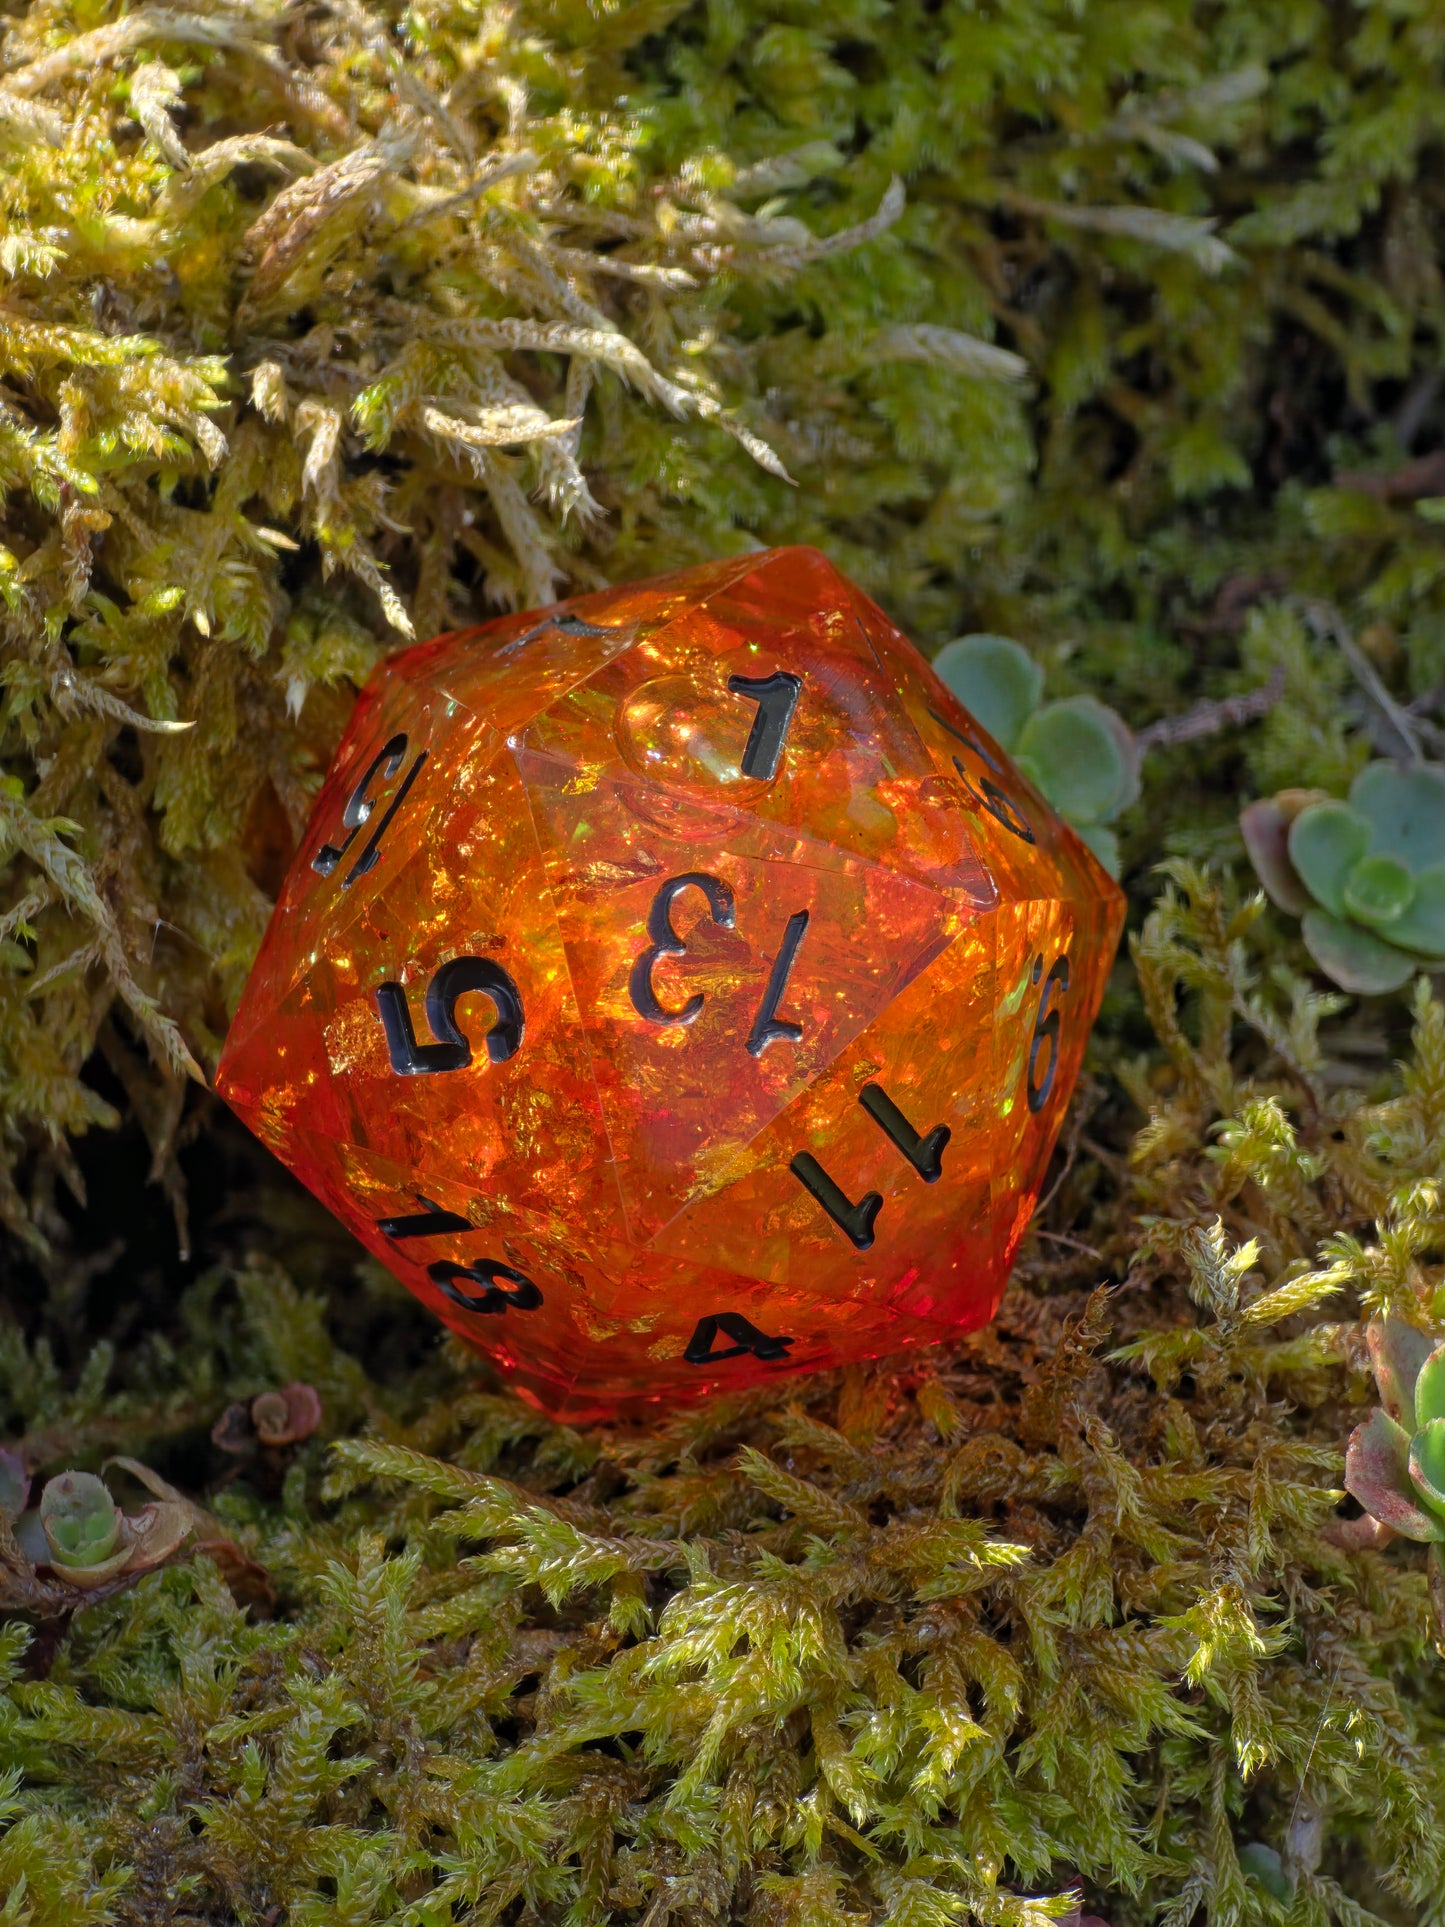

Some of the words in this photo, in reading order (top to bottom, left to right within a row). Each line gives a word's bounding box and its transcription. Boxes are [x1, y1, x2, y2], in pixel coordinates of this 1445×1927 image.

[727, 671, 802, 781] 1
[310, 733, 429, 890] 15
[375, 956, 526, 1076] 5
[629, 872, 811, 1058] 13
[790, 1081, 952, 1251] 11
[377, 1194, 544, 1315] 18
[683, 1311, 795, 1364] 4
